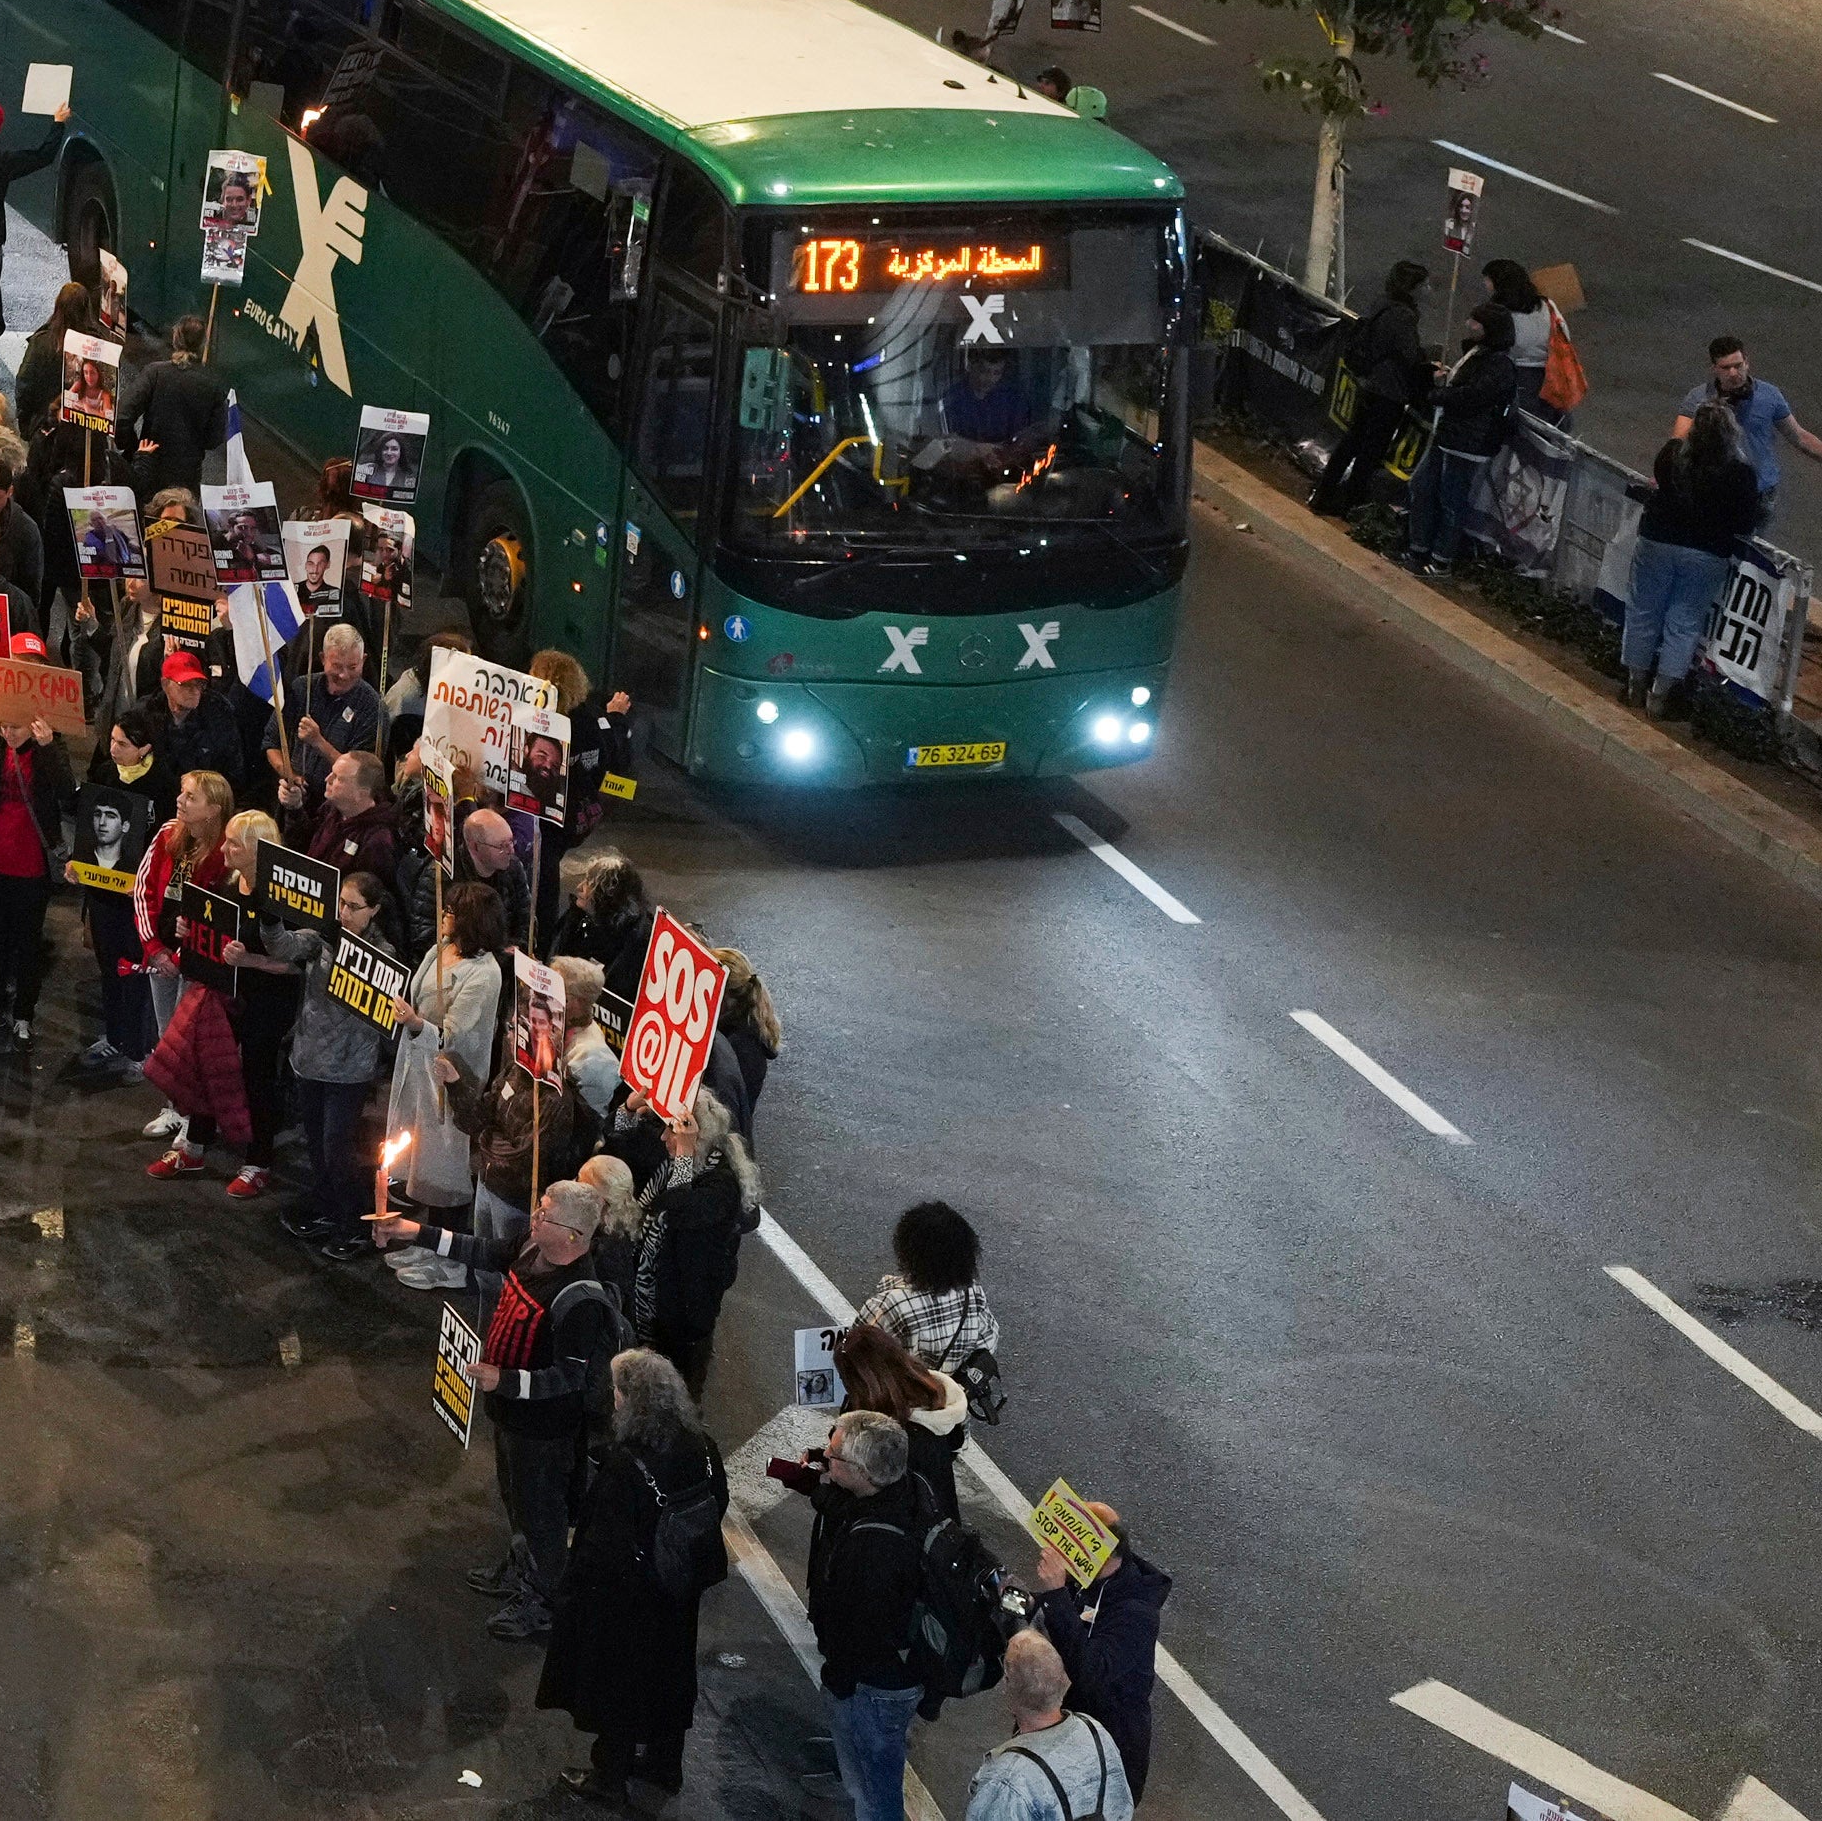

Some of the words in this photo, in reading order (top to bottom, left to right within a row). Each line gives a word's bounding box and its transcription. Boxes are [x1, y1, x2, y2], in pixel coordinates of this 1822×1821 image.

[803, 239, 860, 292] 173
[889, 246, 972, 281] المركزية
[976, 244, 1041, 275] المحطة
[38, 672, 80, 704] END
[432, 681, 513, 724] השותפות
[605, 779, 625, 792] אוהד
[84, 871, 110, 884] שרעבי
[112, 878, 126, 888] אלי
[272, 864, 322, 898] עסקה
[336, 936, 372, 980] בבית
[371, 957, 405, 997] אתם
[328, 965, 373, 1016] בעזה!
[645, 931, 722, 1040] SOS
[373, 992, 395, 1031] הם
[630, 1011, 706, 1115] @IL
[440, 1307, 478, 1358] הימים
[435, 1355, 471, 1401] החטופים
[1034, 1510, 1060, 1535] STOP
[1058, 1533, 1077, 1558] THE
[1072, 1555, 1094, 1576] WAR
